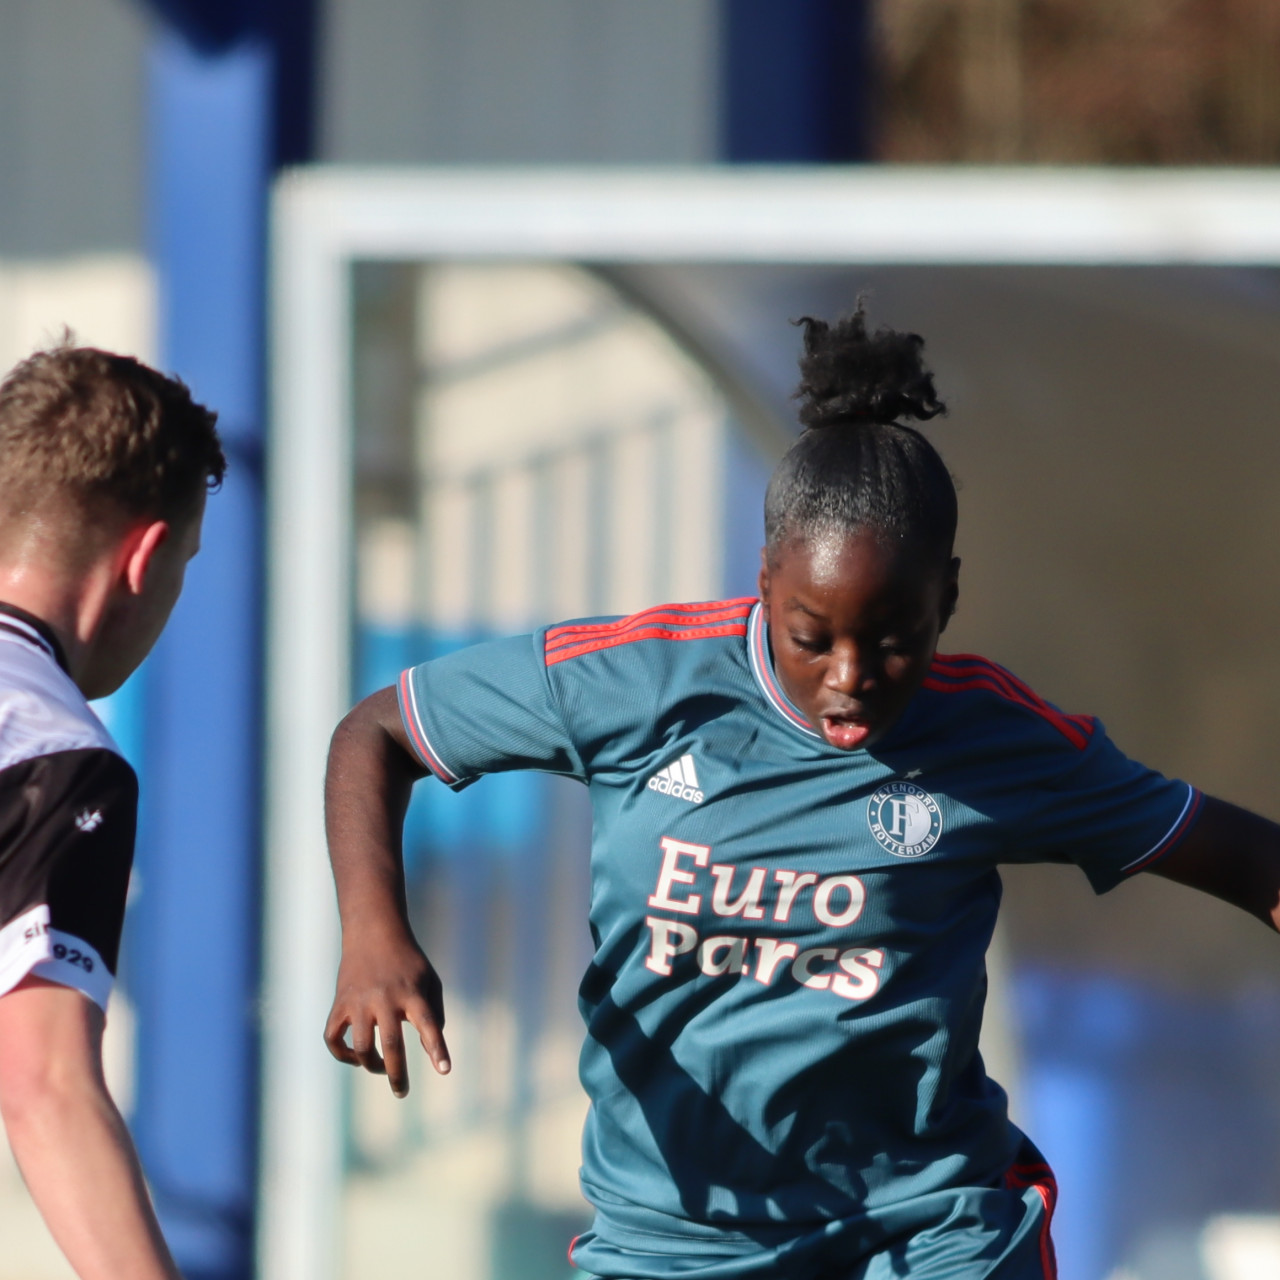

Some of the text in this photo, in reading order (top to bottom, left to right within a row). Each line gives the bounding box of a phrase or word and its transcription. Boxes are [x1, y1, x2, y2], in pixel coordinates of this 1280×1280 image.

[648, 776, 704, 804] adidas
[872, 783, 937, 813] FEYENOORD
[871, 822, 936, 855] ROTTERDAM
[647, 836, 866, 927] Euro
[52, 943, 94, 974] 929
[645, 916, 886, 1000] Parcs
